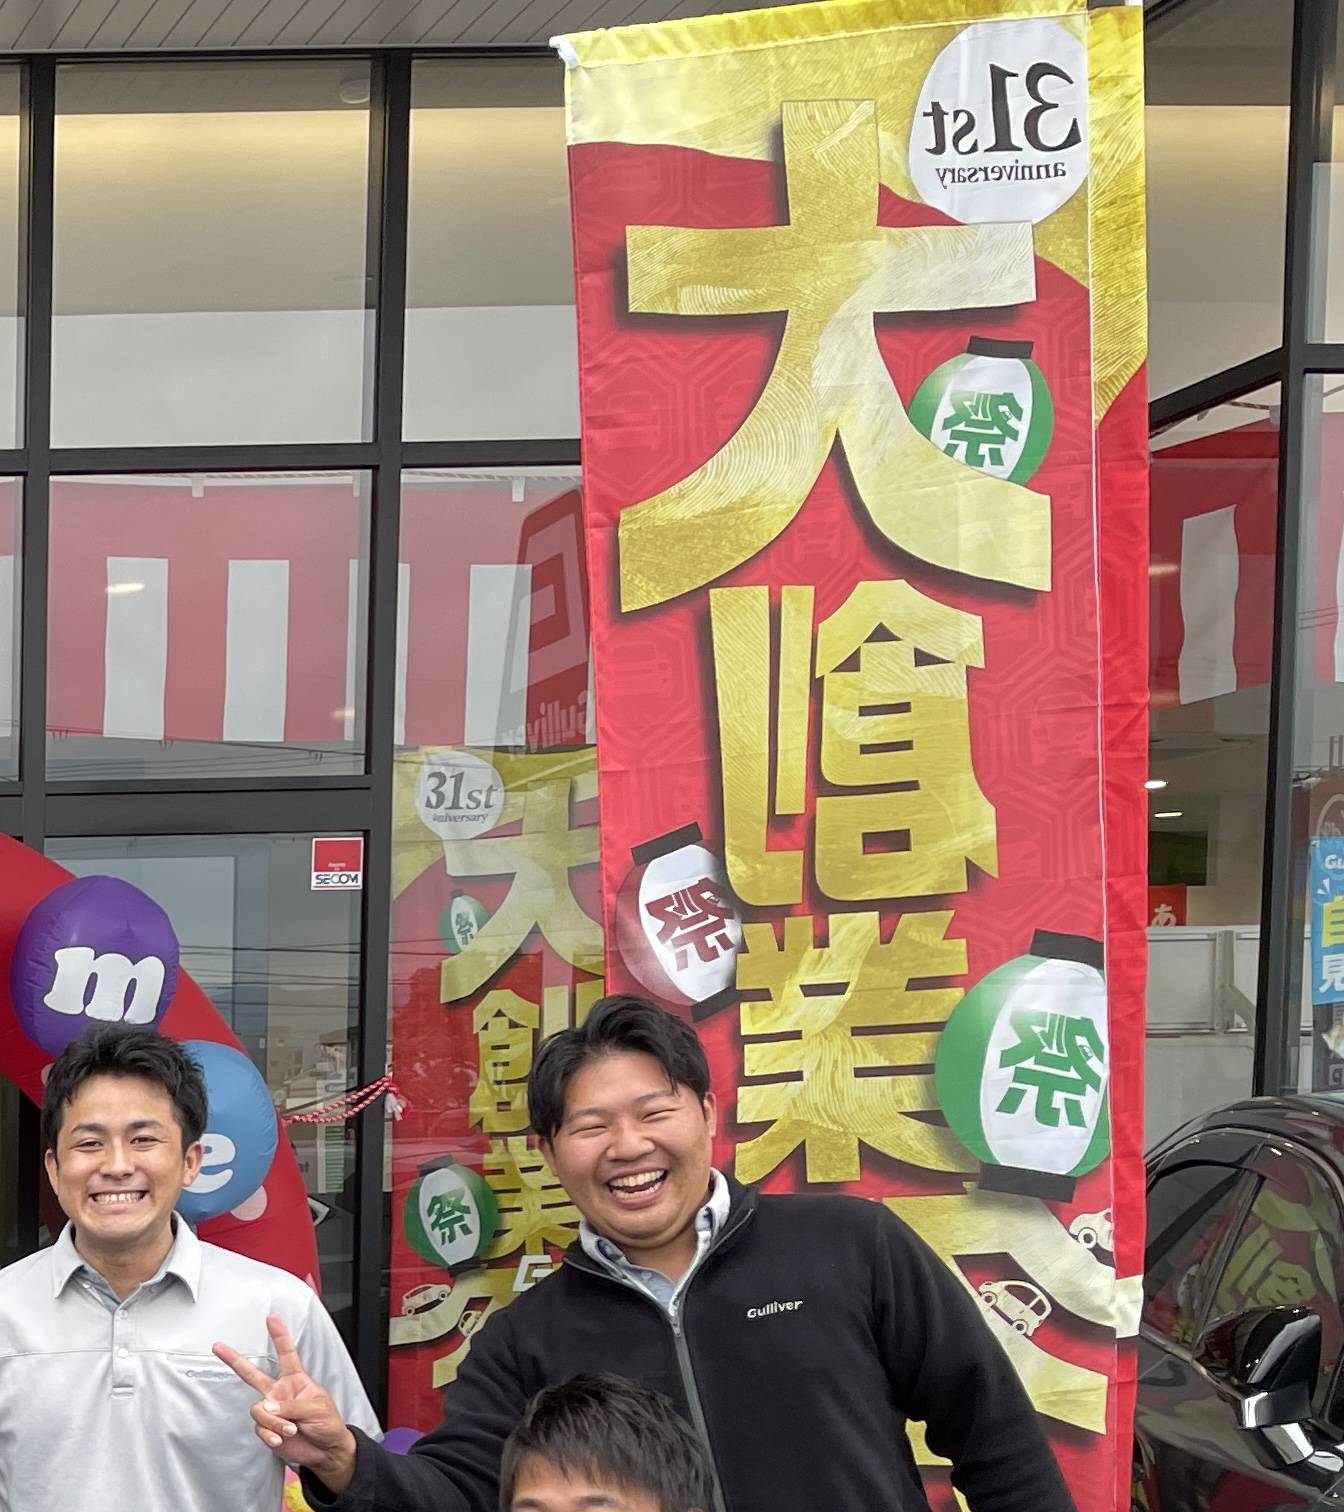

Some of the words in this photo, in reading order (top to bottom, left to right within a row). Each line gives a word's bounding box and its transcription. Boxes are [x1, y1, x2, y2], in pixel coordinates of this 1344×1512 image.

[424, 770, 497, 811] 31st
[315, 873, 359, 885] SECOM
[427, 1187, 472, 1246] 祭
[745, 1298, 804, 1320] Gulliver
